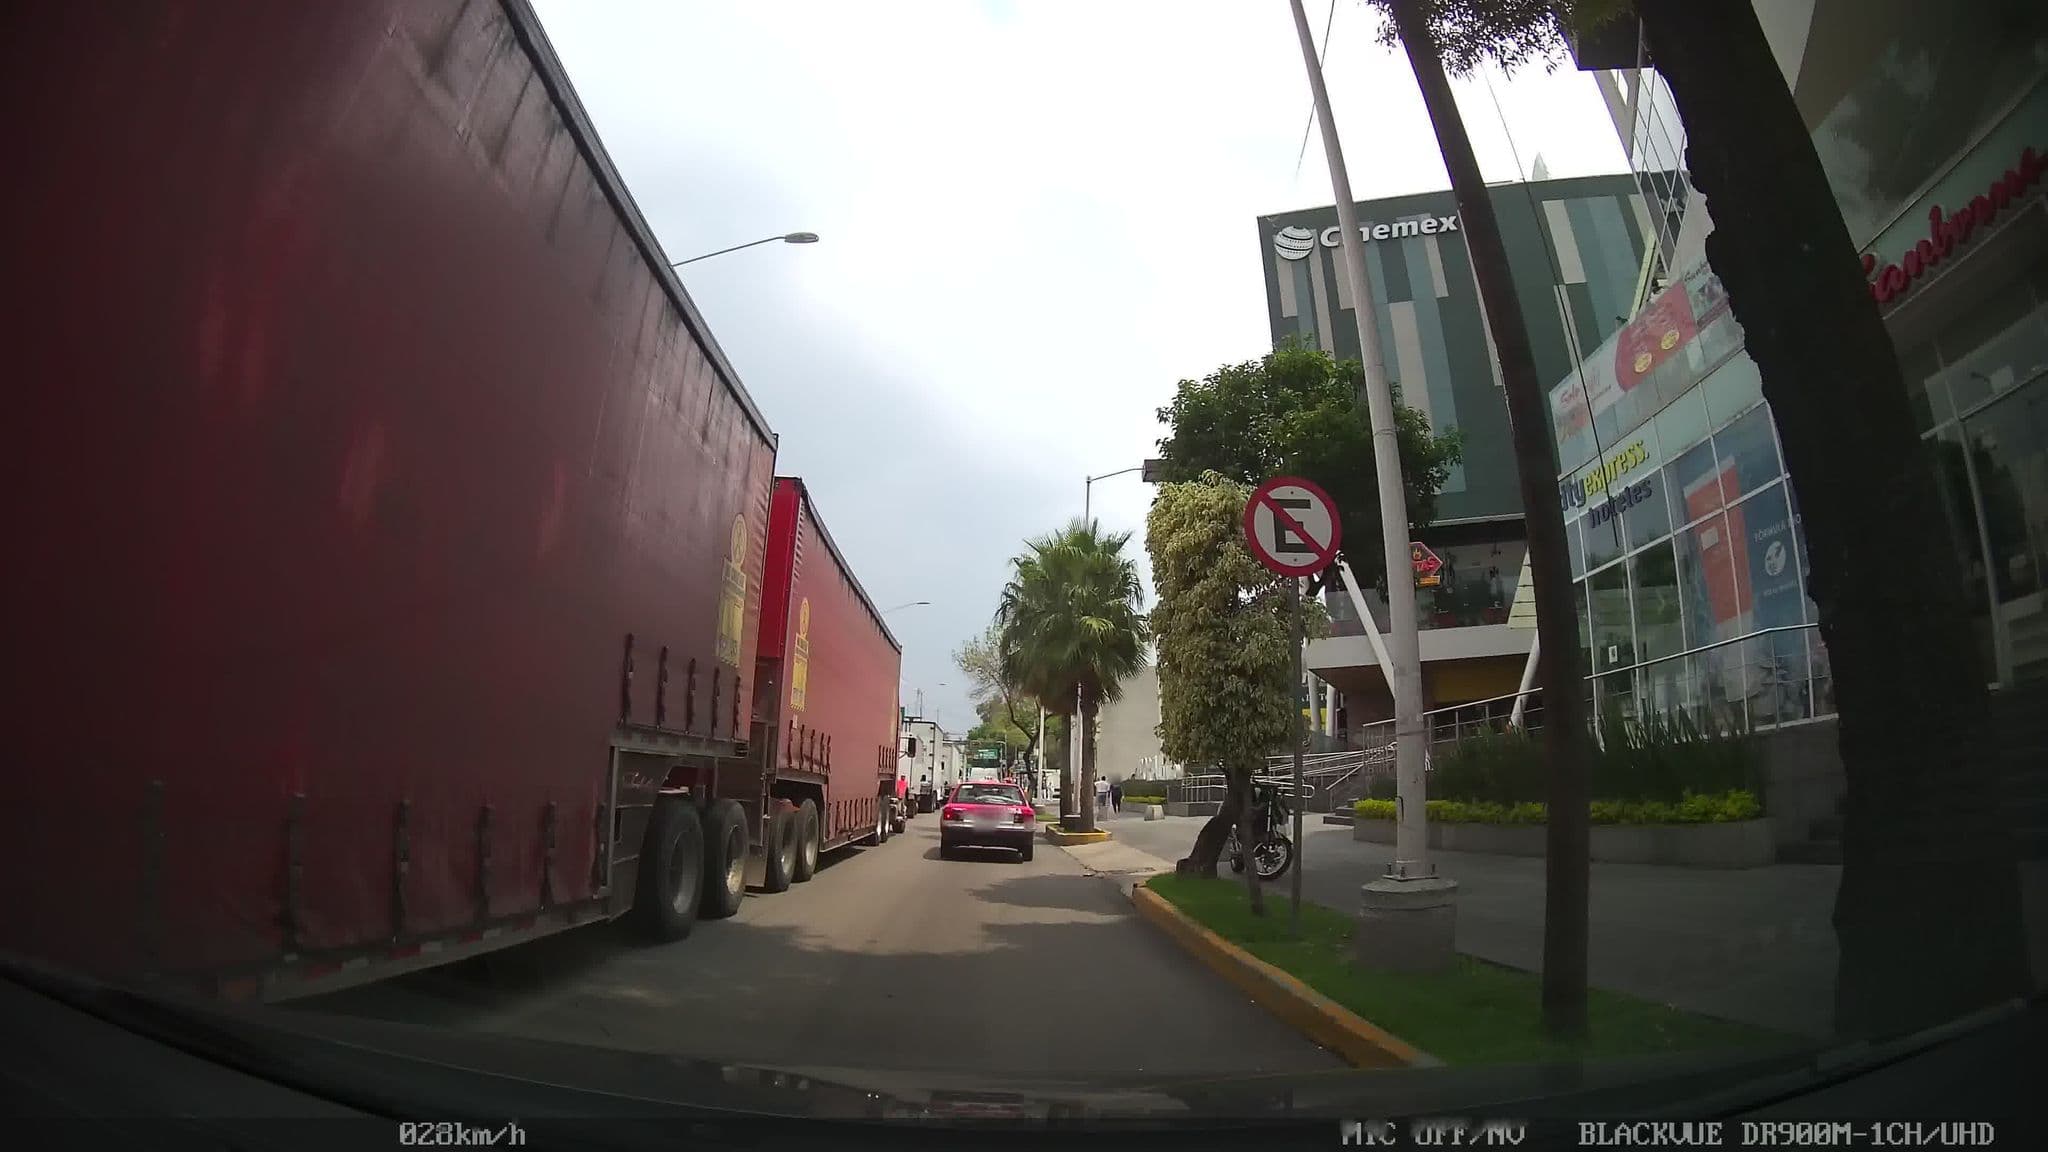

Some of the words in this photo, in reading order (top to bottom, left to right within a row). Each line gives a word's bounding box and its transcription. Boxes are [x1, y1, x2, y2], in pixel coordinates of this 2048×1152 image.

[1319, 212, 1461, 249] Cnemex
[1271, 498, 1316, 554] E
[1588, 480, 1653, 529] hoteles
